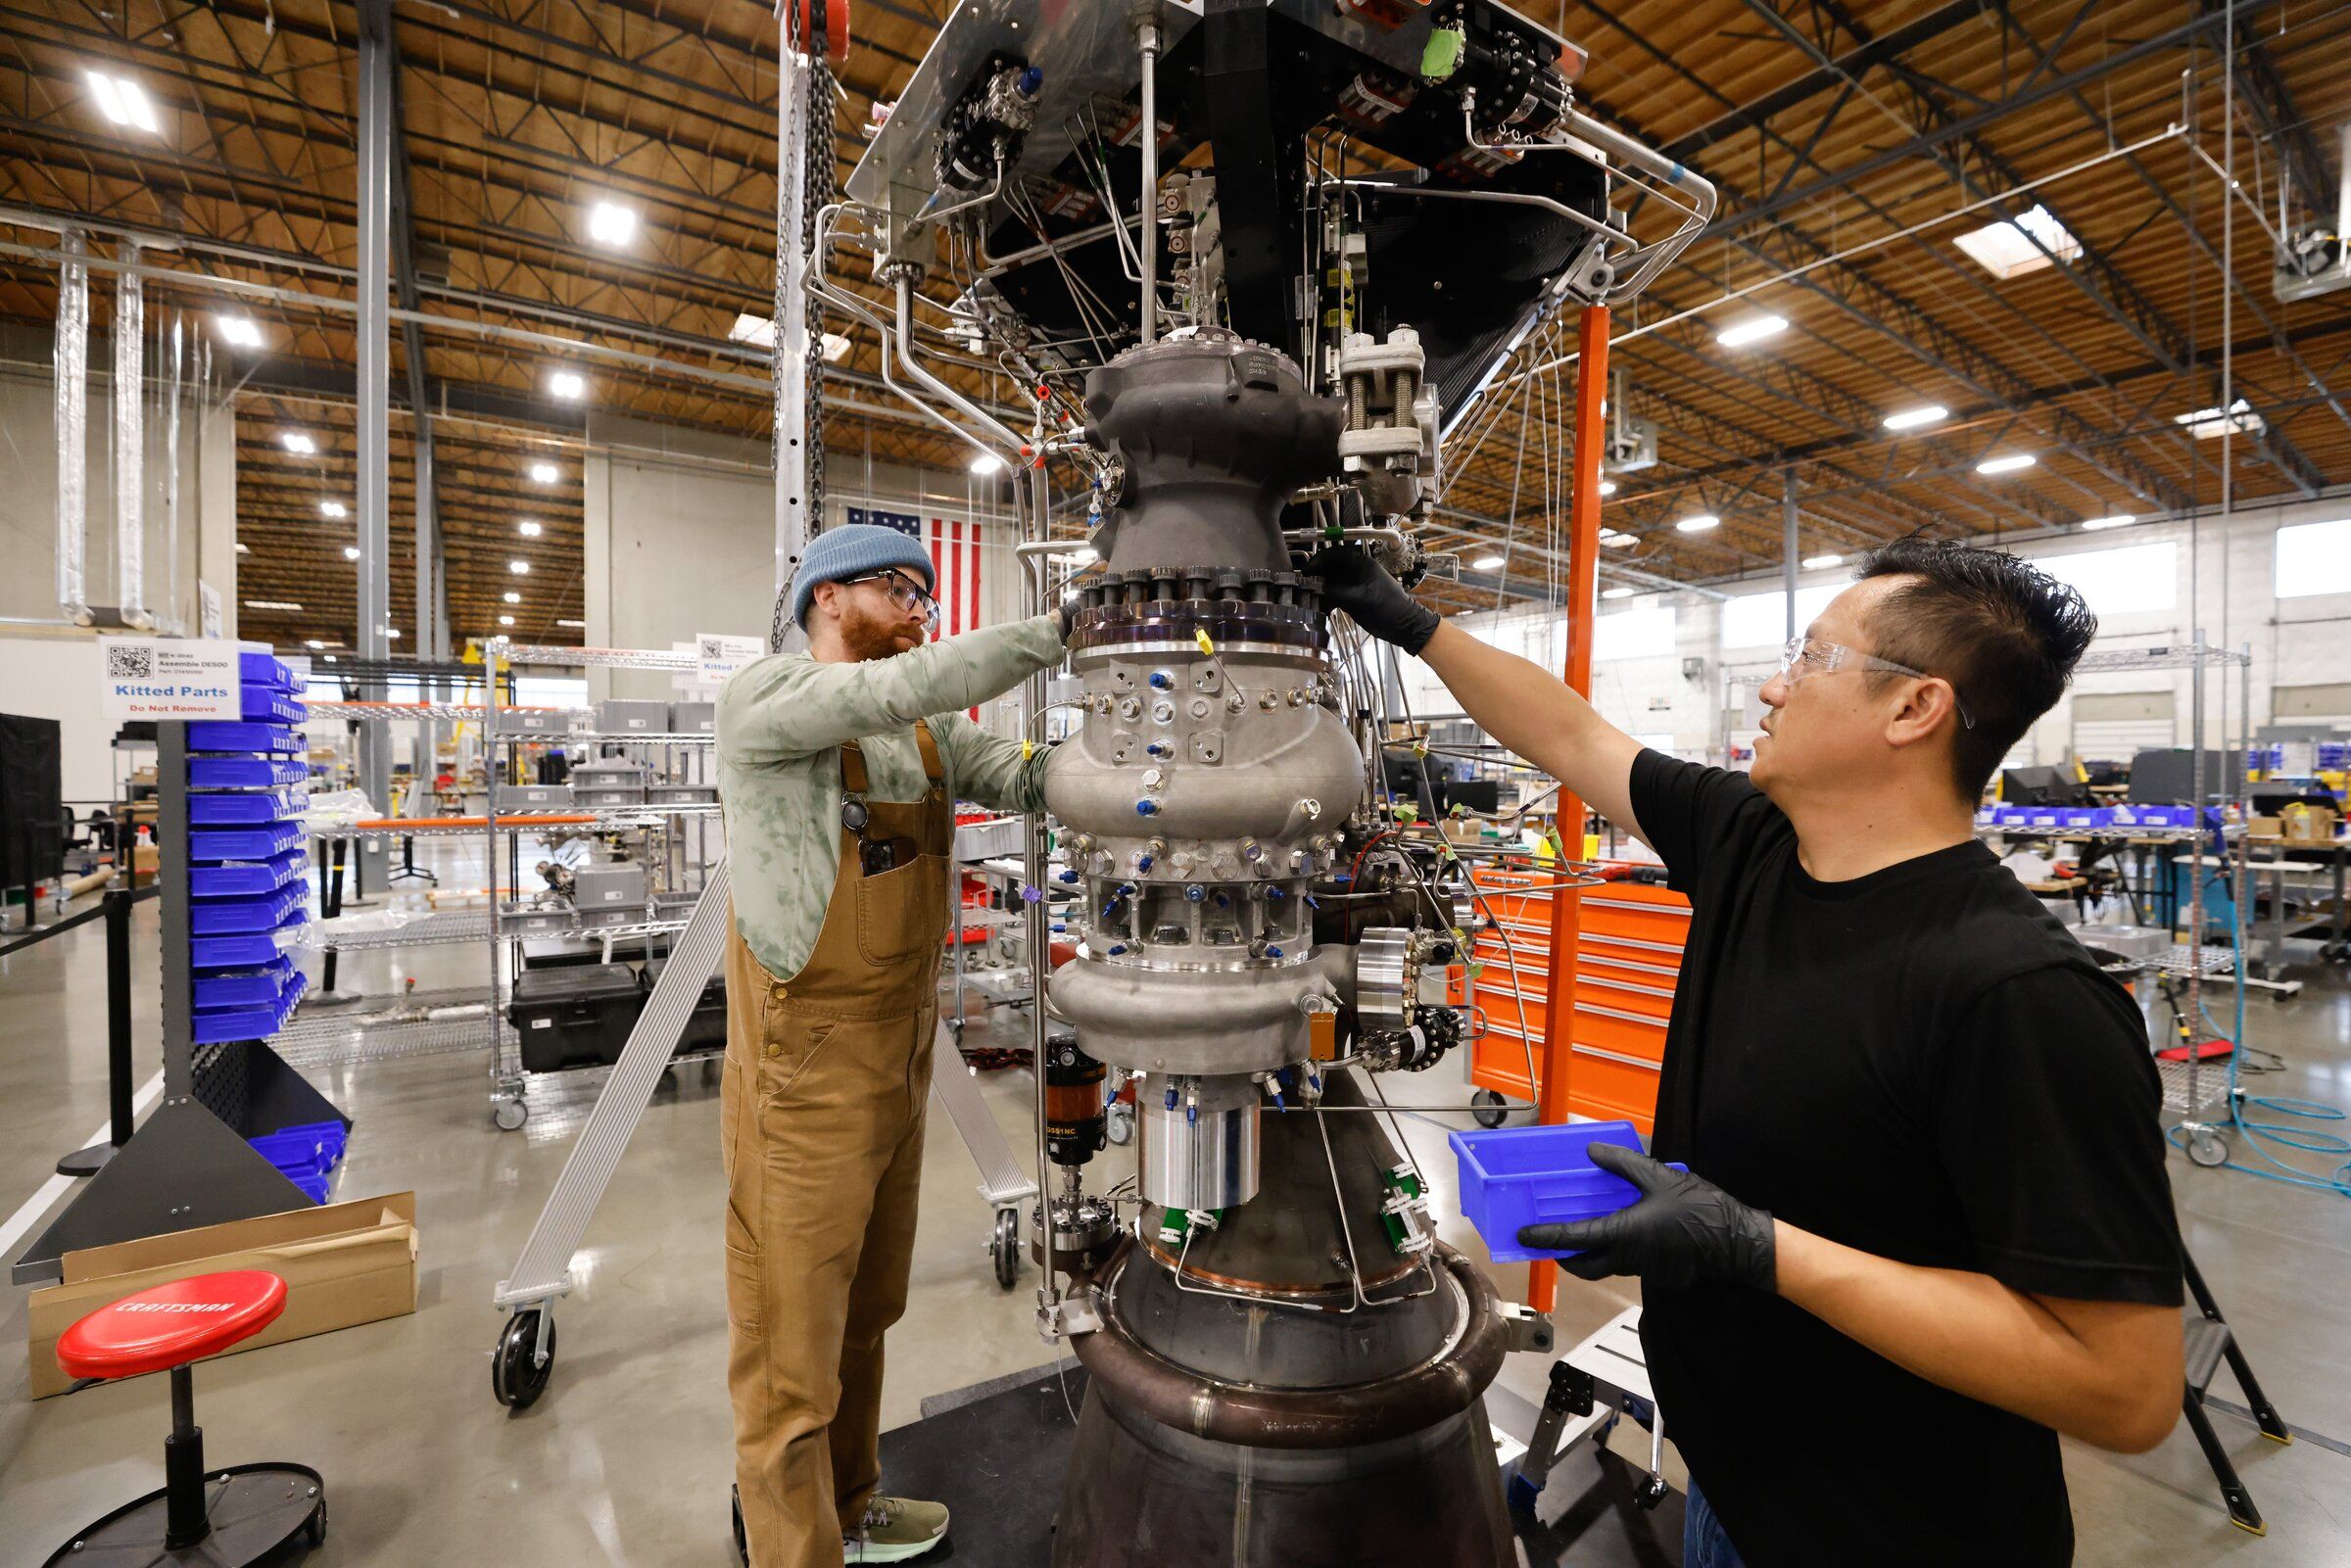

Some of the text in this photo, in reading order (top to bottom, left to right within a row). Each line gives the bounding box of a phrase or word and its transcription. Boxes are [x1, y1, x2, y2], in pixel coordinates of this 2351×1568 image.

[115, 685, 228, 697] Kitted Parts
[116, 1303, 236, 1313] CRAFTSMAN
